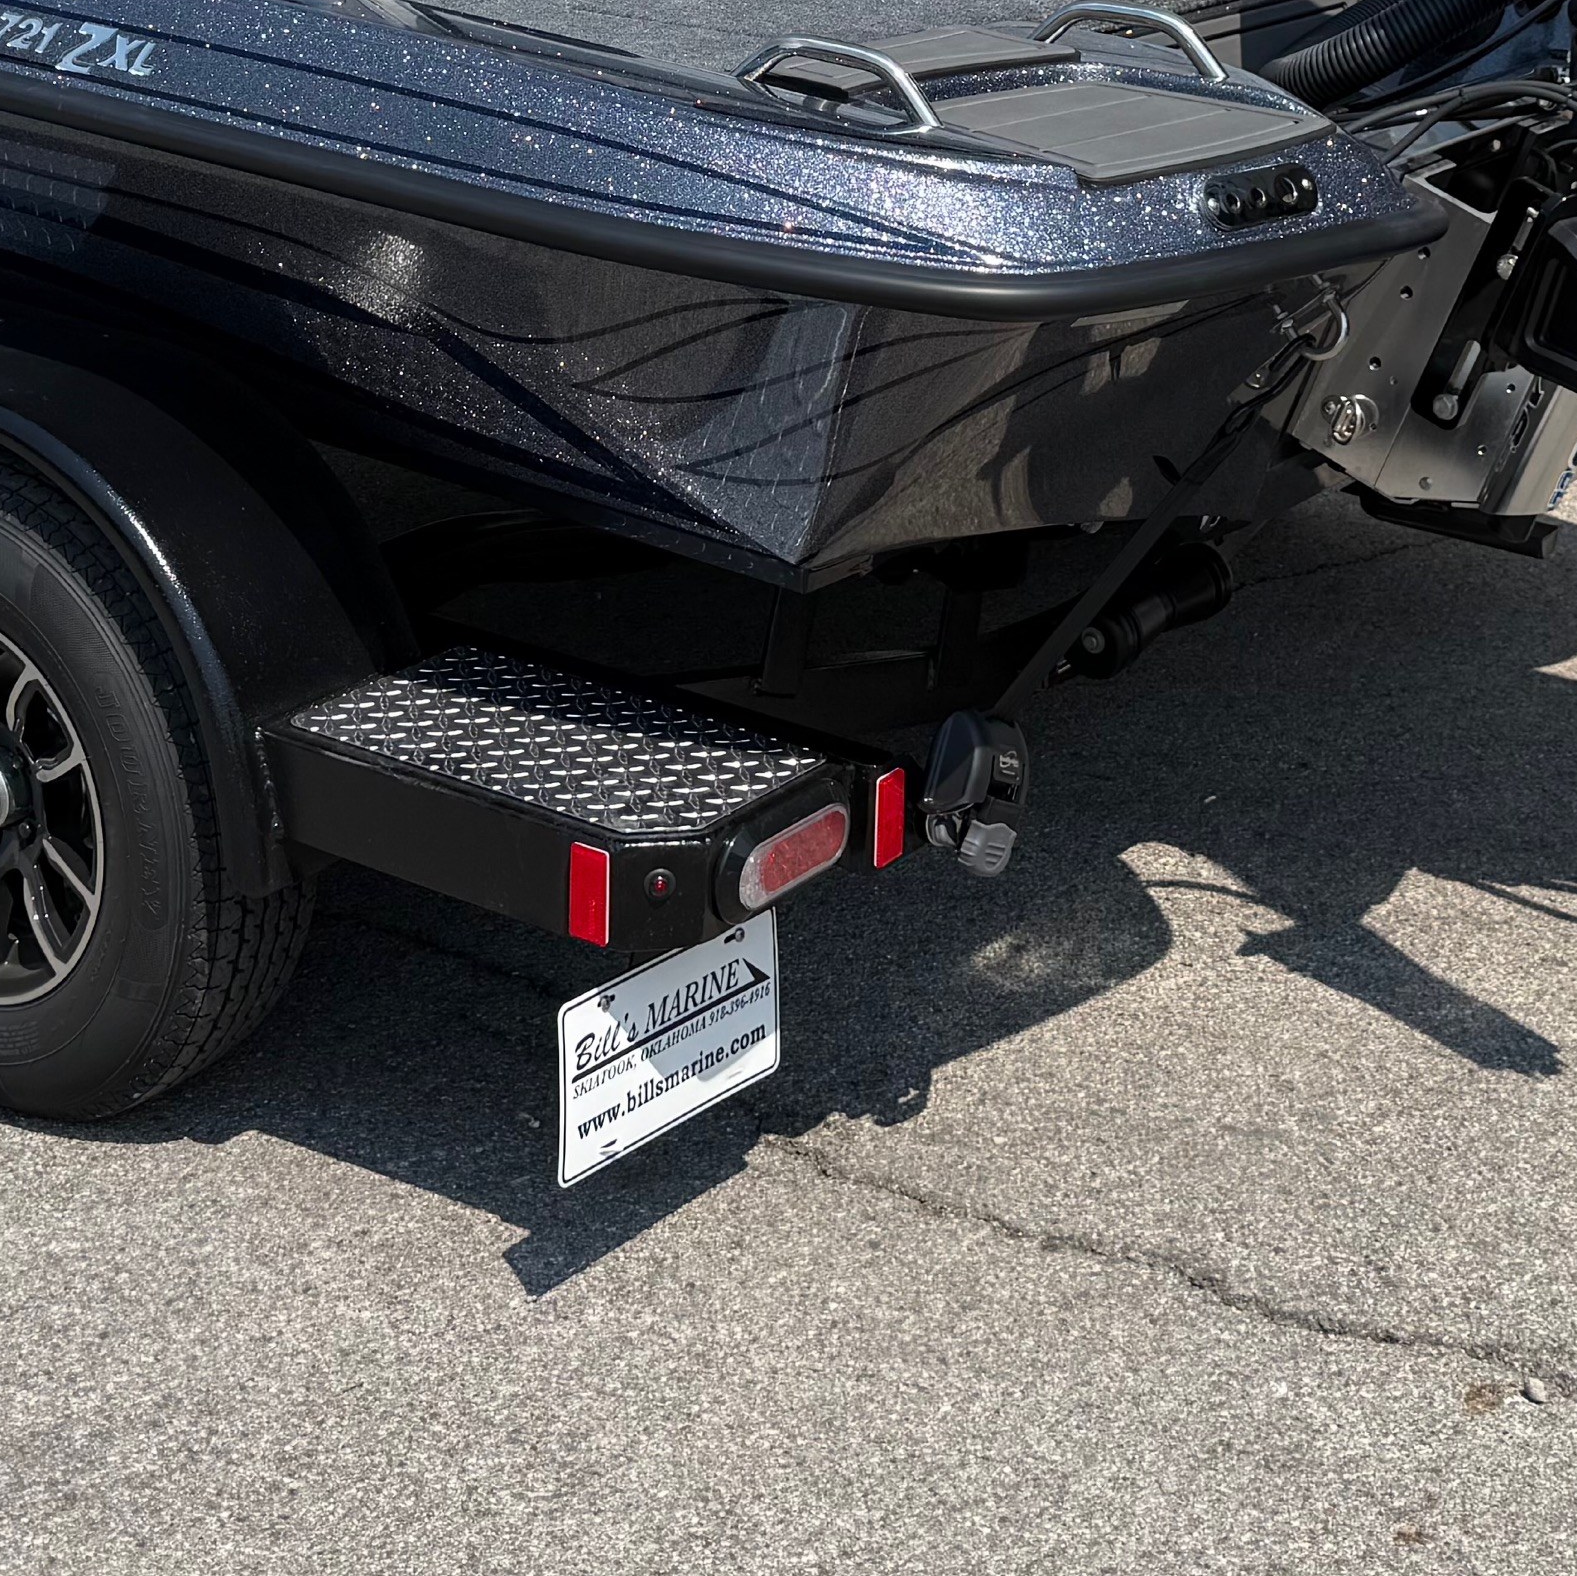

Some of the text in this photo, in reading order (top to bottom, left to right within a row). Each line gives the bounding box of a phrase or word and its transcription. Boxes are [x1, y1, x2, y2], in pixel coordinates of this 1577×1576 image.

[572, 981, 772, 1100] SKIATOOK, OKLAHOMA 918-396-4916
[575, 958, 741, 1071] Bill's MARINE
[576, 1024, 768, 1140] www.billsmarine.com
